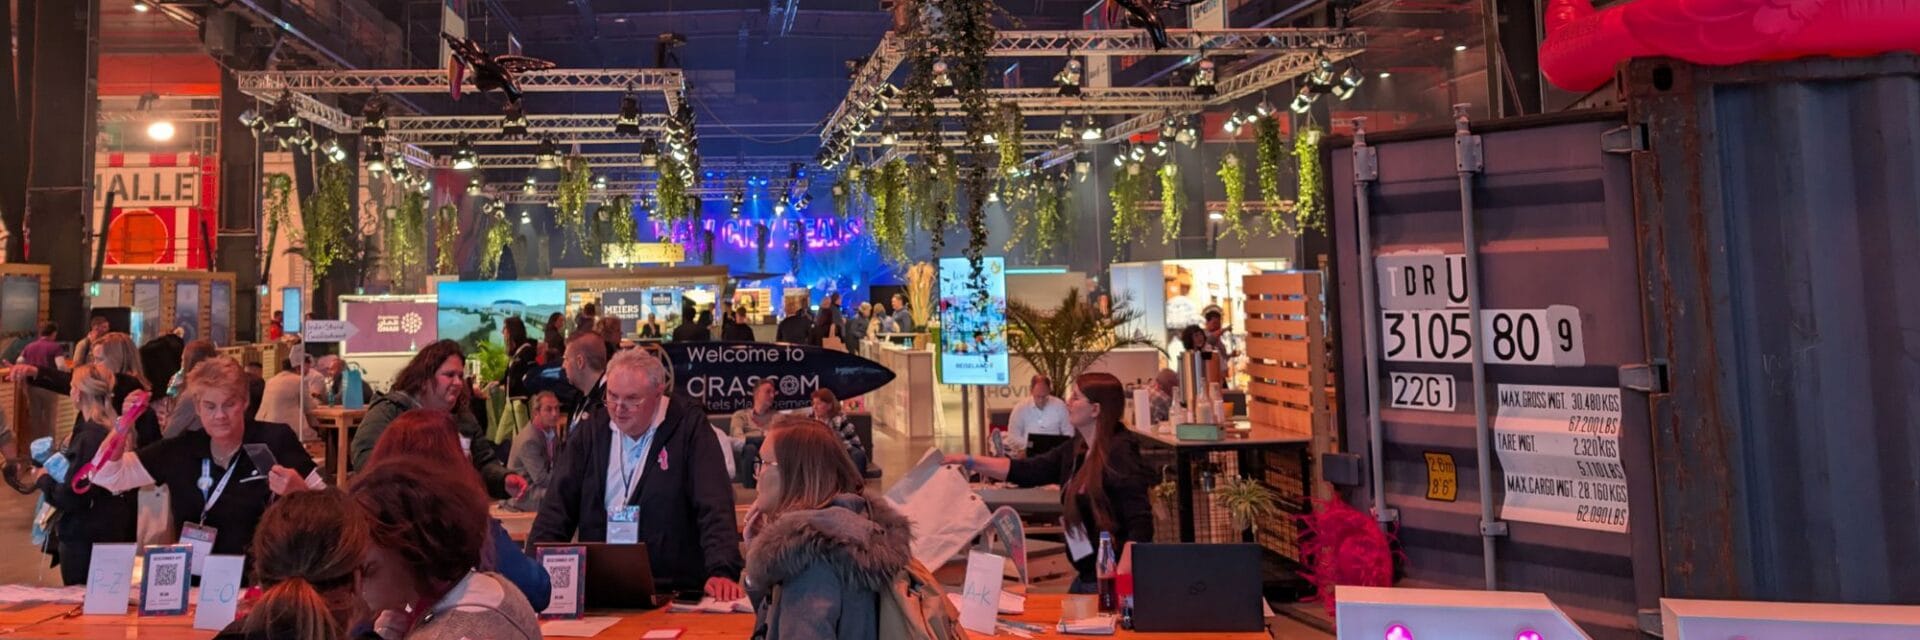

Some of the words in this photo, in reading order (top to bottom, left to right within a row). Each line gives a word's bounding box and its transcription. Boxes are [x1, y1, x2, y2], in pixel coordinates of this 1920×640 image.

[604, 305, 639, 314] MEIERS
[1557, 318, 1573, 352] 9
[686, 345, 779, 363] Welcome
[786, 345, 804, 362] to
[1394, 375, 1453, 408] 22G1
[1498, 433, 1517, 451] TARE
